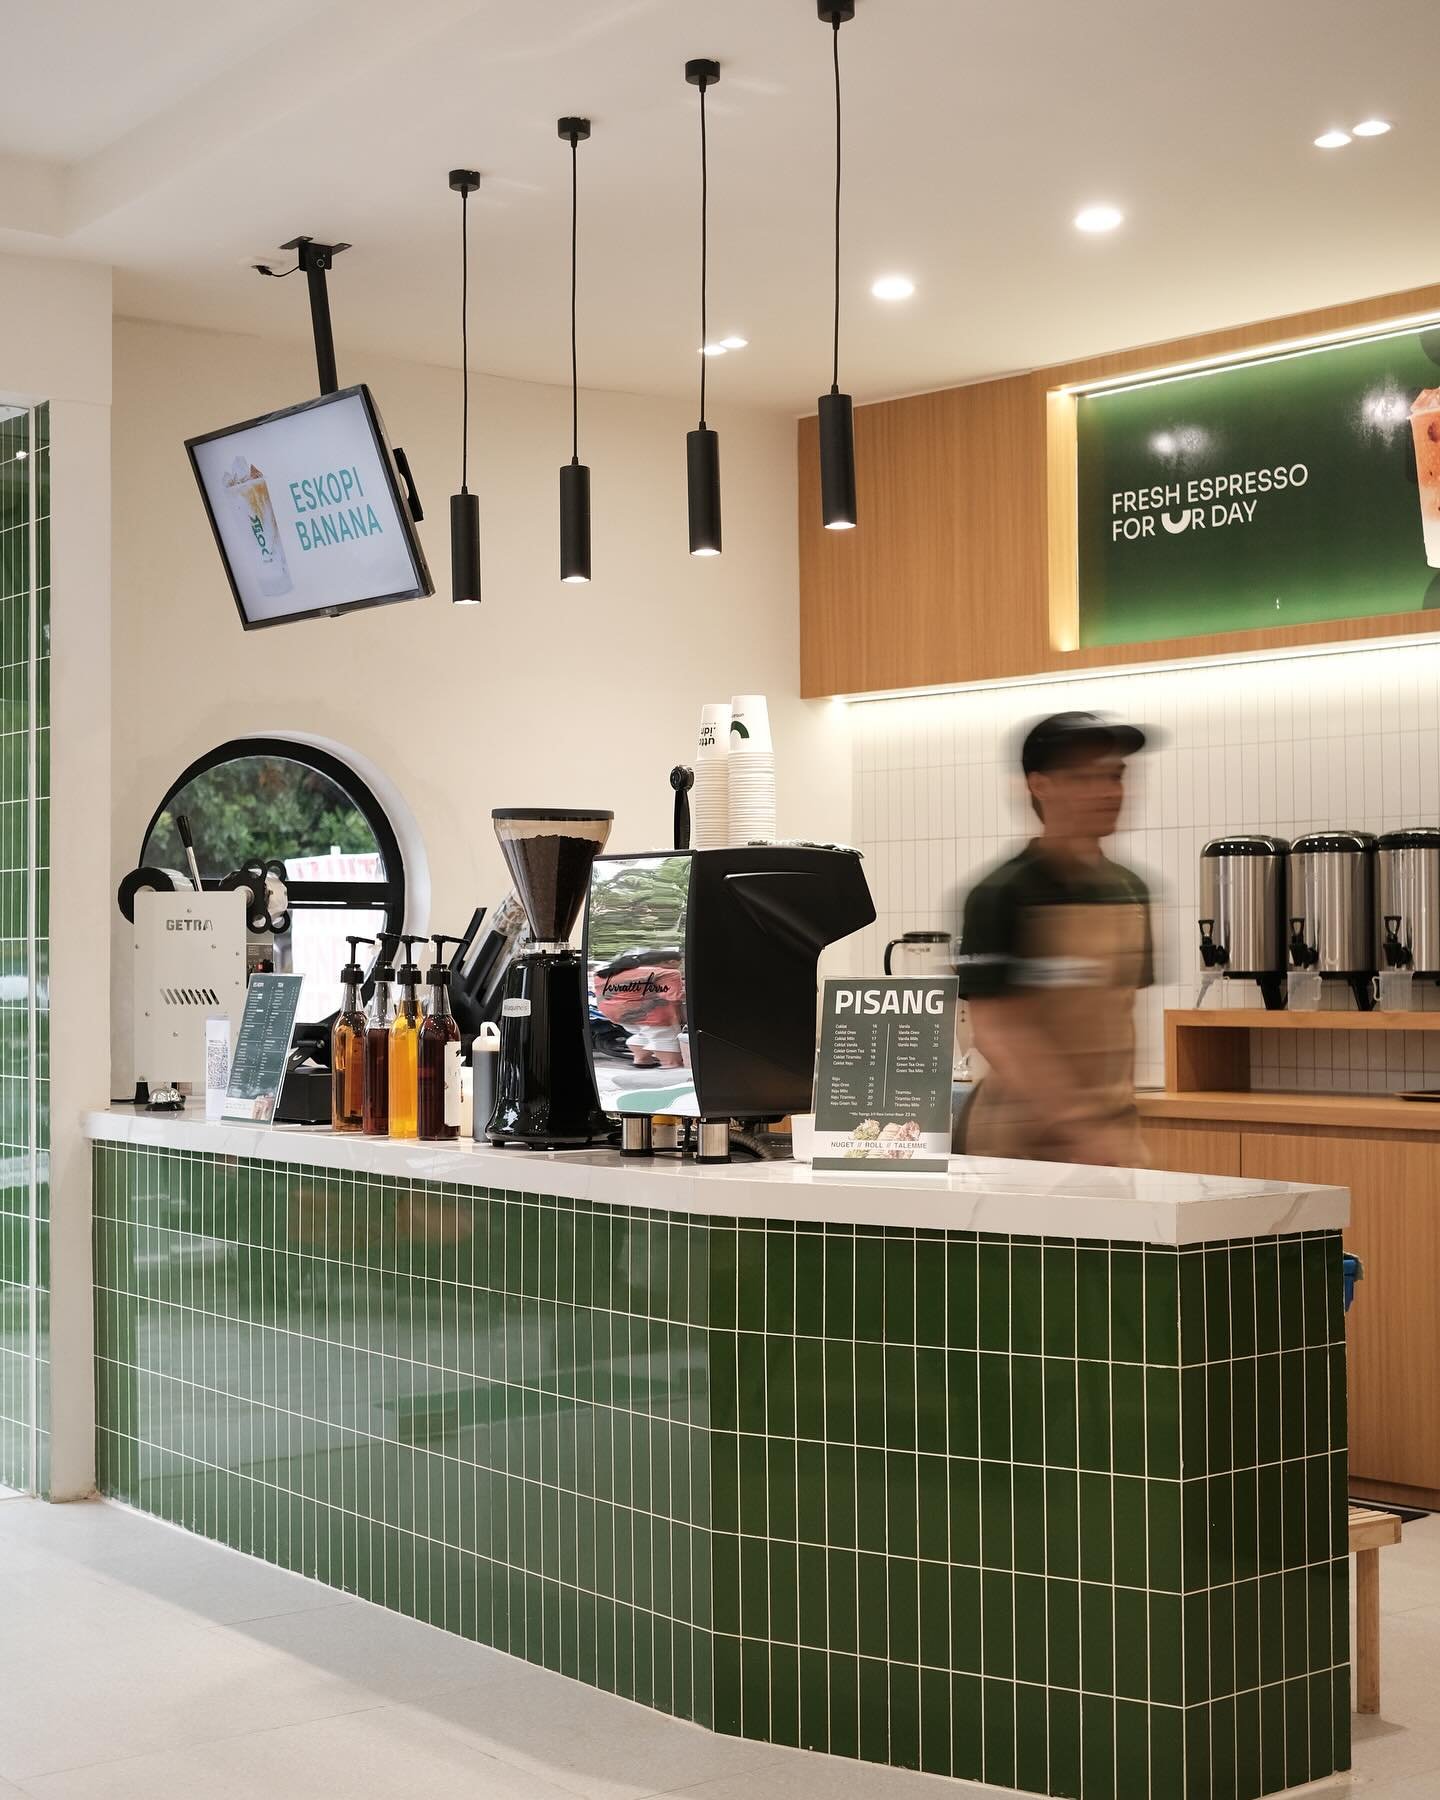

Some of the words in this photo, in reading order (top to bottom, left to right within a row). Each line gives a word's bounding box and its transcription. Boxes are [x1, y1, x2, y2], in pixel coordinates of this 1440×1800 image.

[289, 466, 365, 513] ESKOPI
[1112, 483, 1180, 514] FRESH
[1187, 463, 1309, 503] ESPRESSO
[295, 503, 383, 551] BANANA
[1112, 515, 1156, 542] FOR
[1211, 499, 1257, 527] DAY
[166, 919, 213, 931] GETRA
[835, 989, 945, 1015] PISANG
